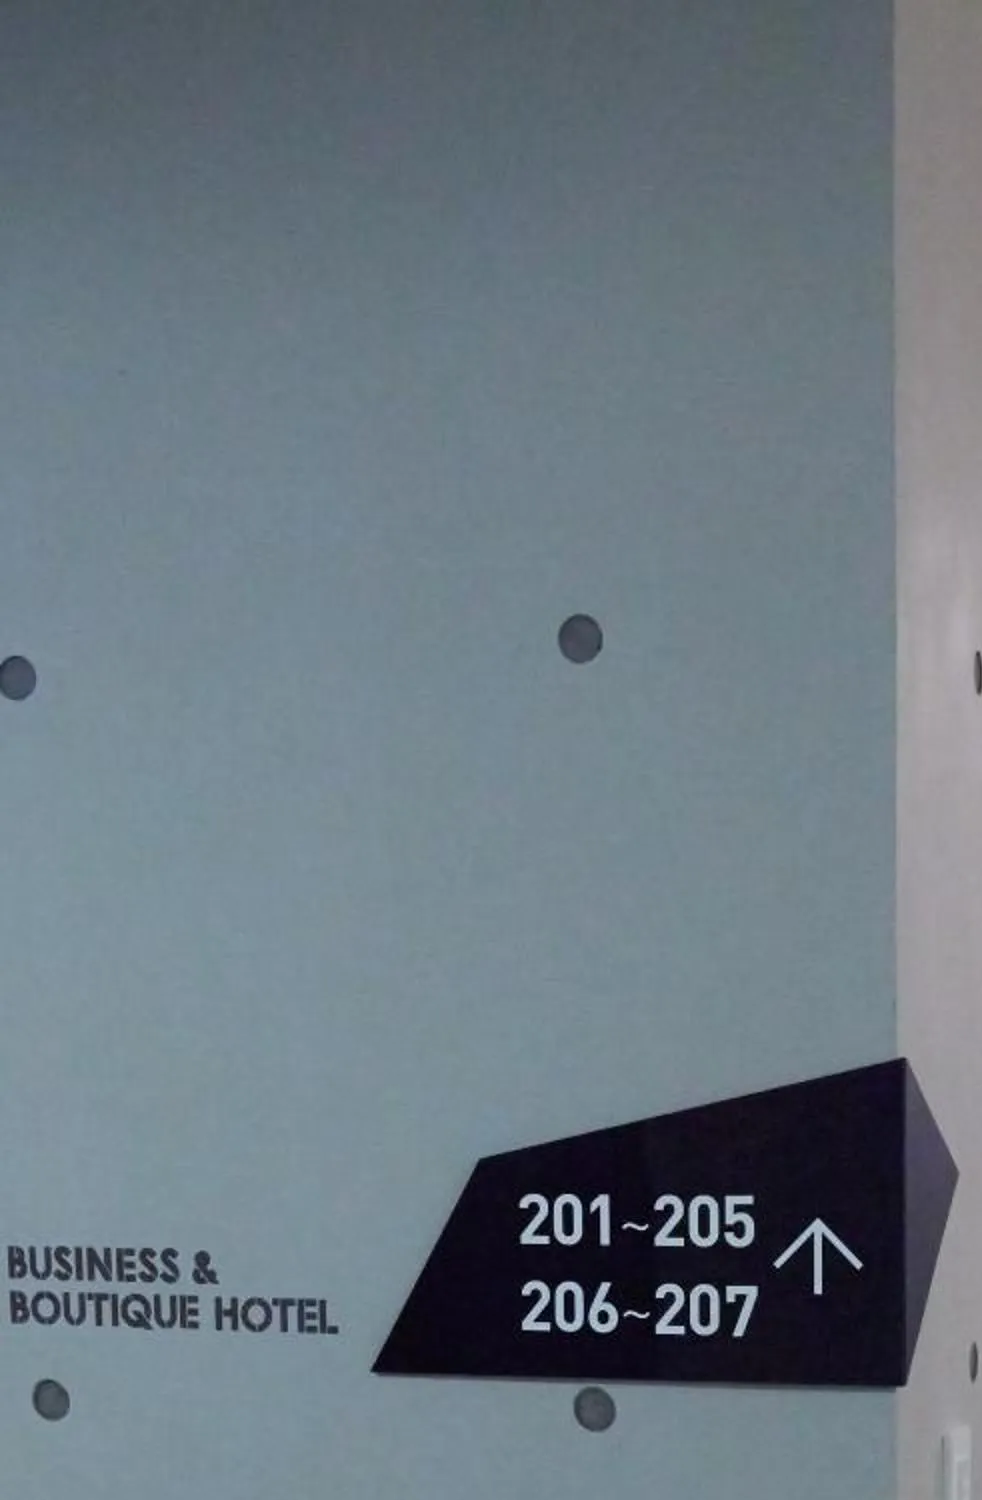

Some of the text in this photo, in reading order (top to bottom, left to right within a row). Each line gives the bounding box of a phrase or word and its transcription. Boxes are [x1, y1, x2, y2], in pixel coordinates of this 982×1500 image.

[518, 1193, 756, 1247] 201~205
[7, 1245, 219, 1285] BUSINESS &
[9, 1290, 339, 1335] BOUTIQUE HOTEL
[520, 1280, 759, 1337] 206~207
